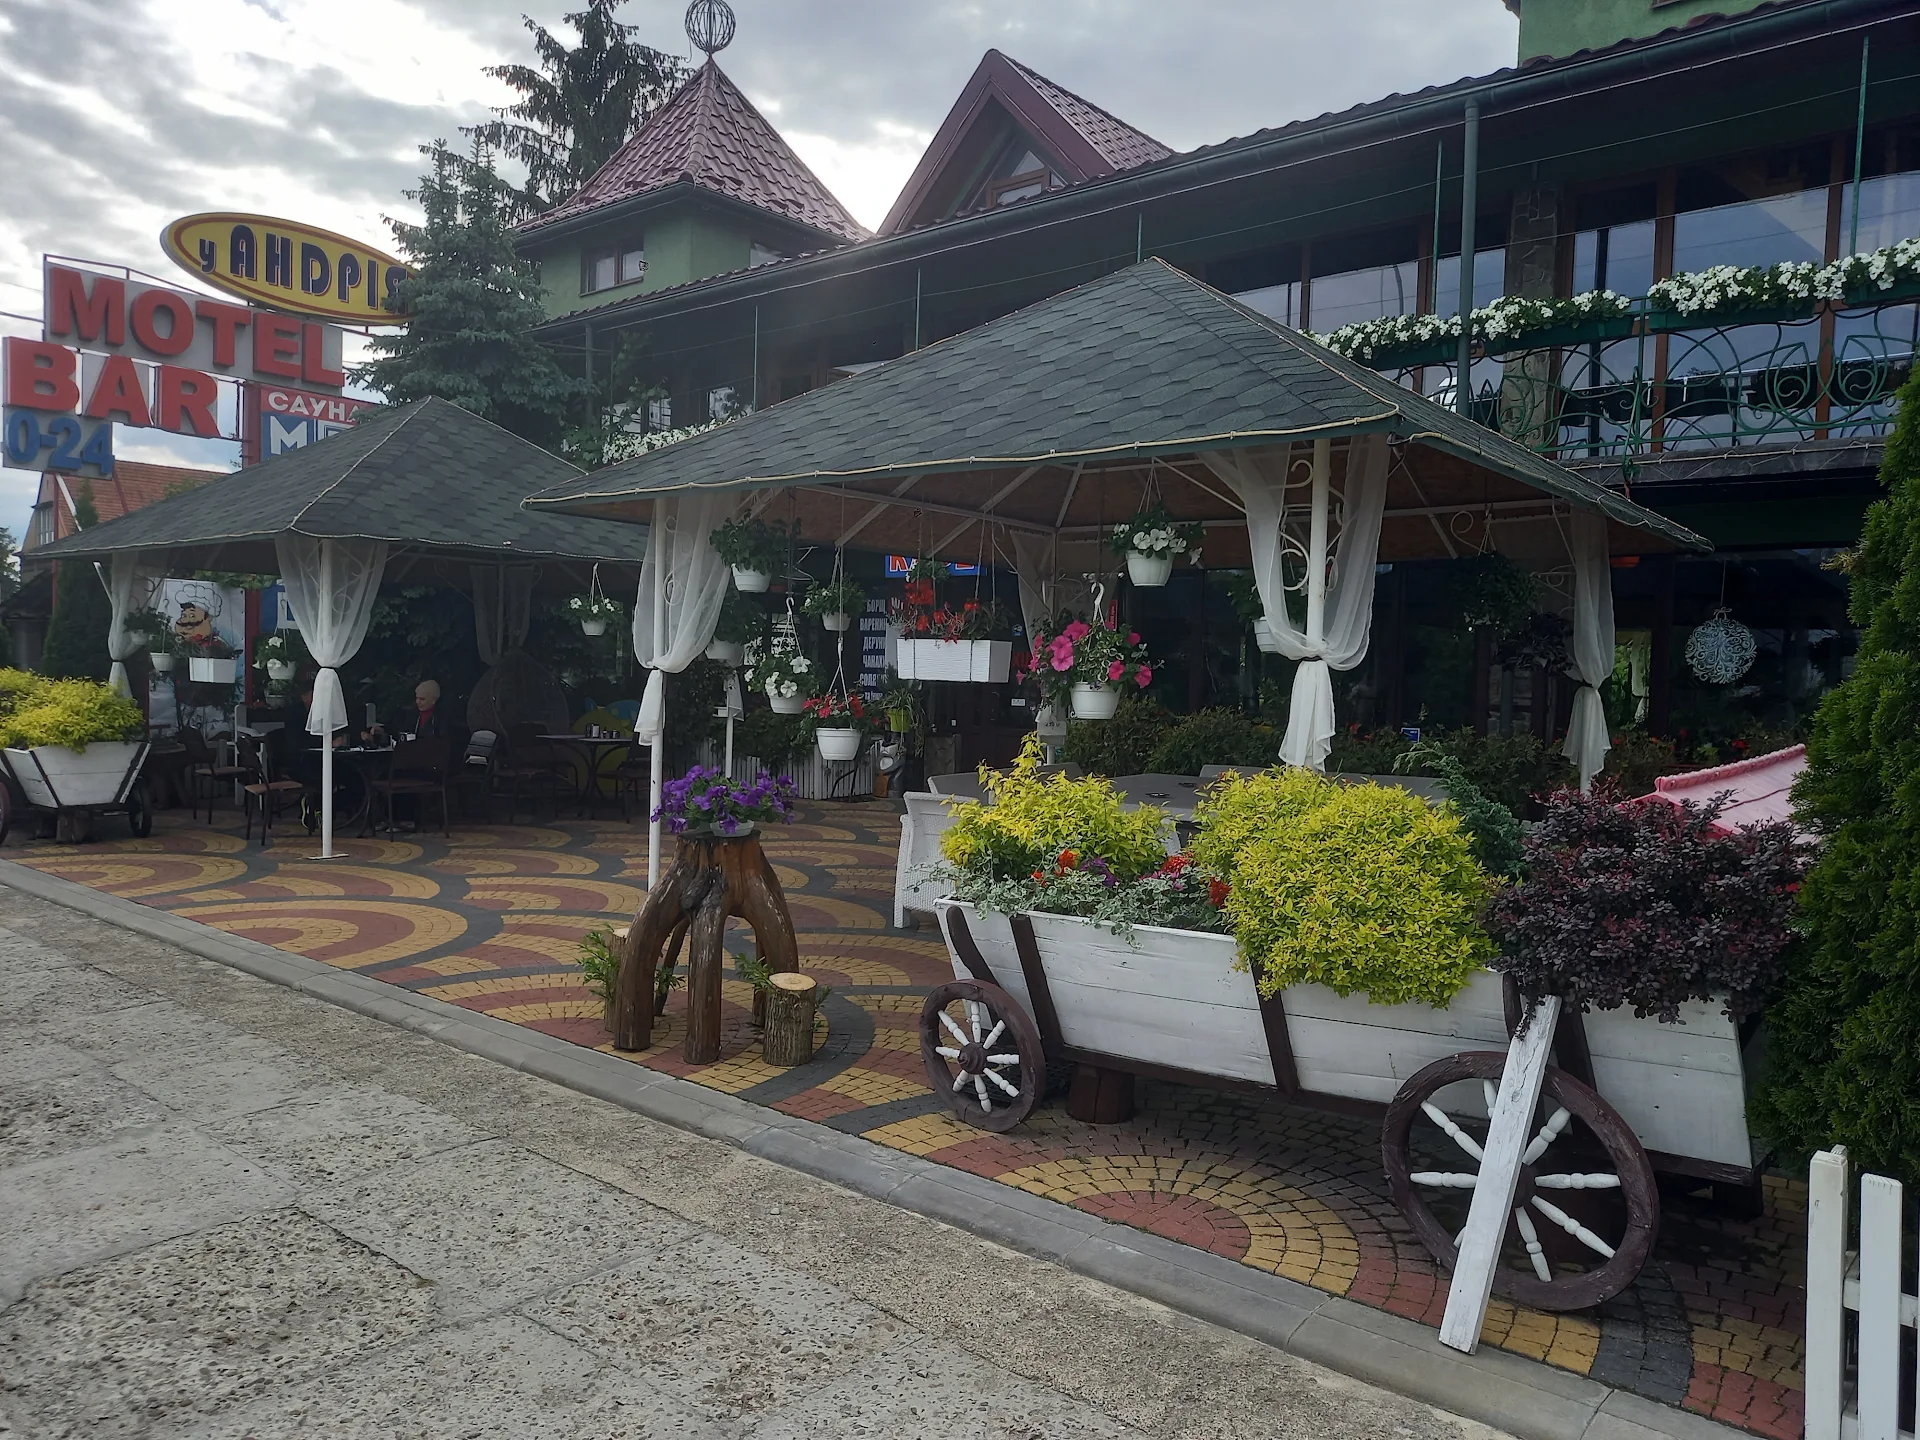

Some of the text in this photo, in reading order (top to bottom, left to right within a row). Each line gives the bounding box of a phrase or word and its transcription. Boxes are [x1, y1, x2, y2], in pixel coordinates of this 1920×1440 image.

[50, 266, 345, 387] MOTEL
[6, 336, 222, 438] BAR
[5, 410, 113, 475] 0-24
